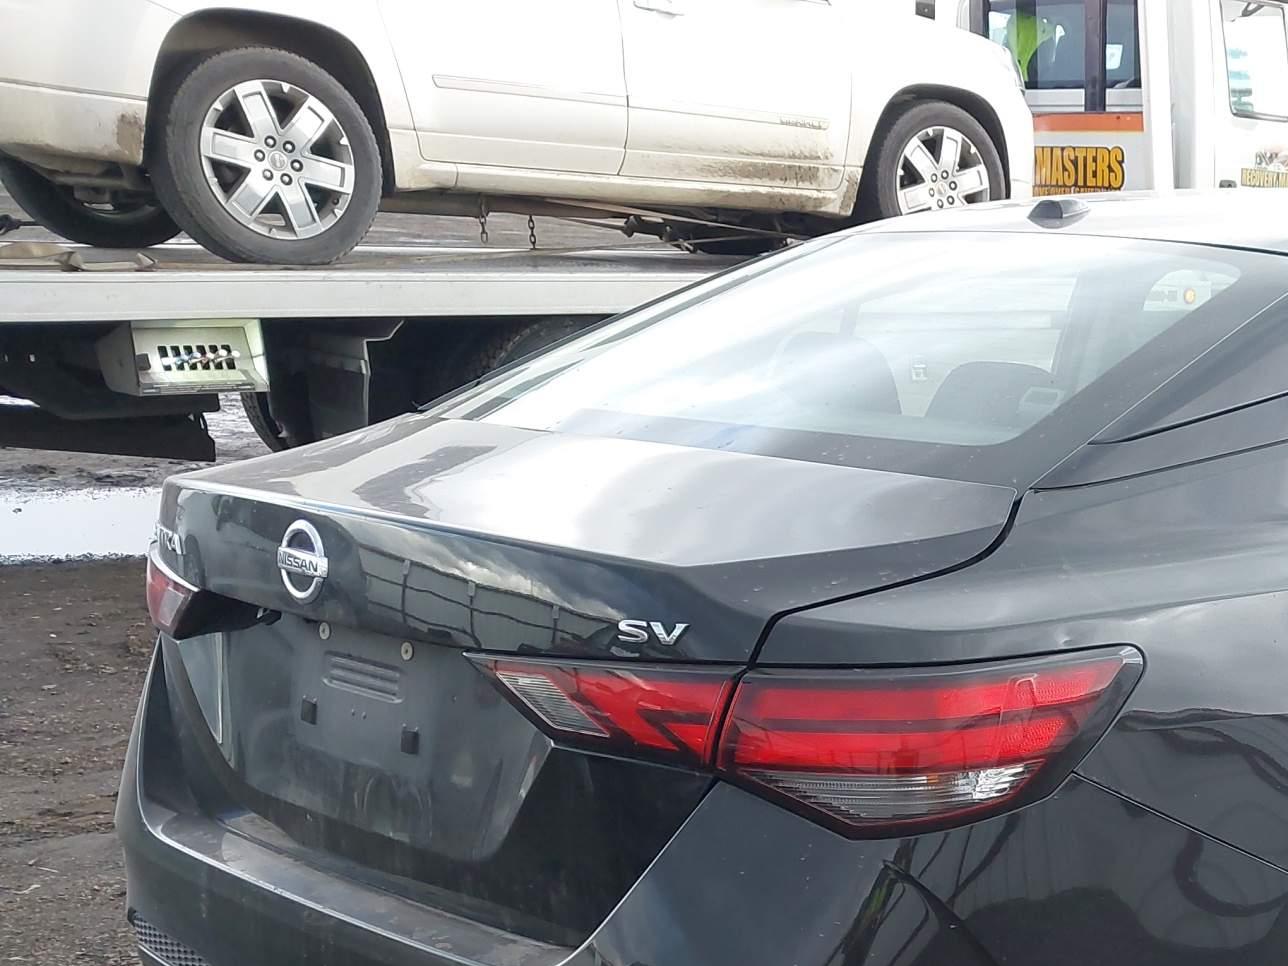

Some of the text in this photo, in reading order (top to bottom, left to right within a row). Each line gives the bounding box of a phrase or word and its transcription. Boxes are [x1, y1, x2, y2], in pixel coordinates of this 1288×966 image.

[1034, 146, 1124, 188] MASTERS
[277, 550, 319, 573] NISSAN
[618, 619, 690, 646] SV
